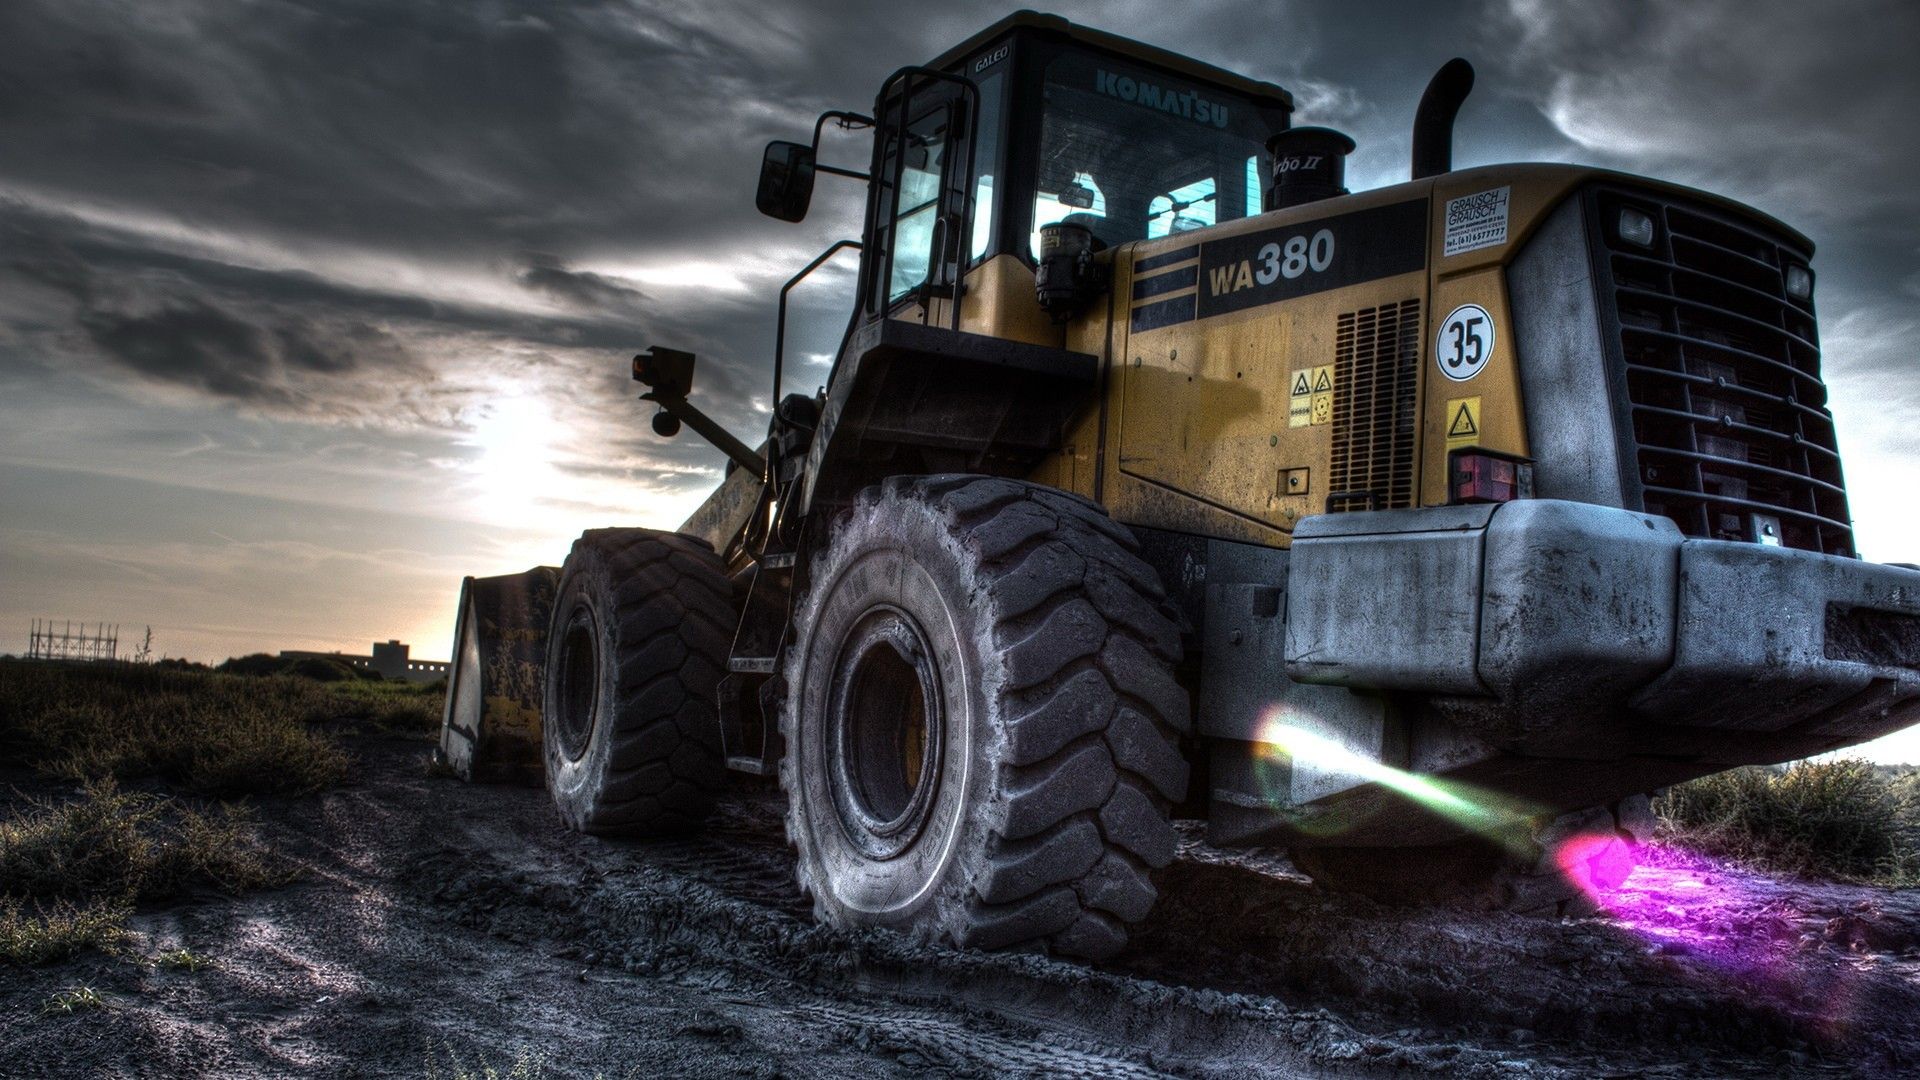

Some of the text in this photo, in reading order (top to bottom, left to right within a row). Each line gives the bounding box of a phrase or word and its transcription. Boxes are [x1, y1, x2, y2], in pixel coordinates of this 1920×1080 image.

[975, 45, 1008, 73] GALEO
[1096, 69, 1229, 128] KOMATSU
[1448, 203, 1497, 226] GRAUSCH
[1450, 190, 1499, 212] GRAUSCH
[1447, 316, 1483, 368] 35
